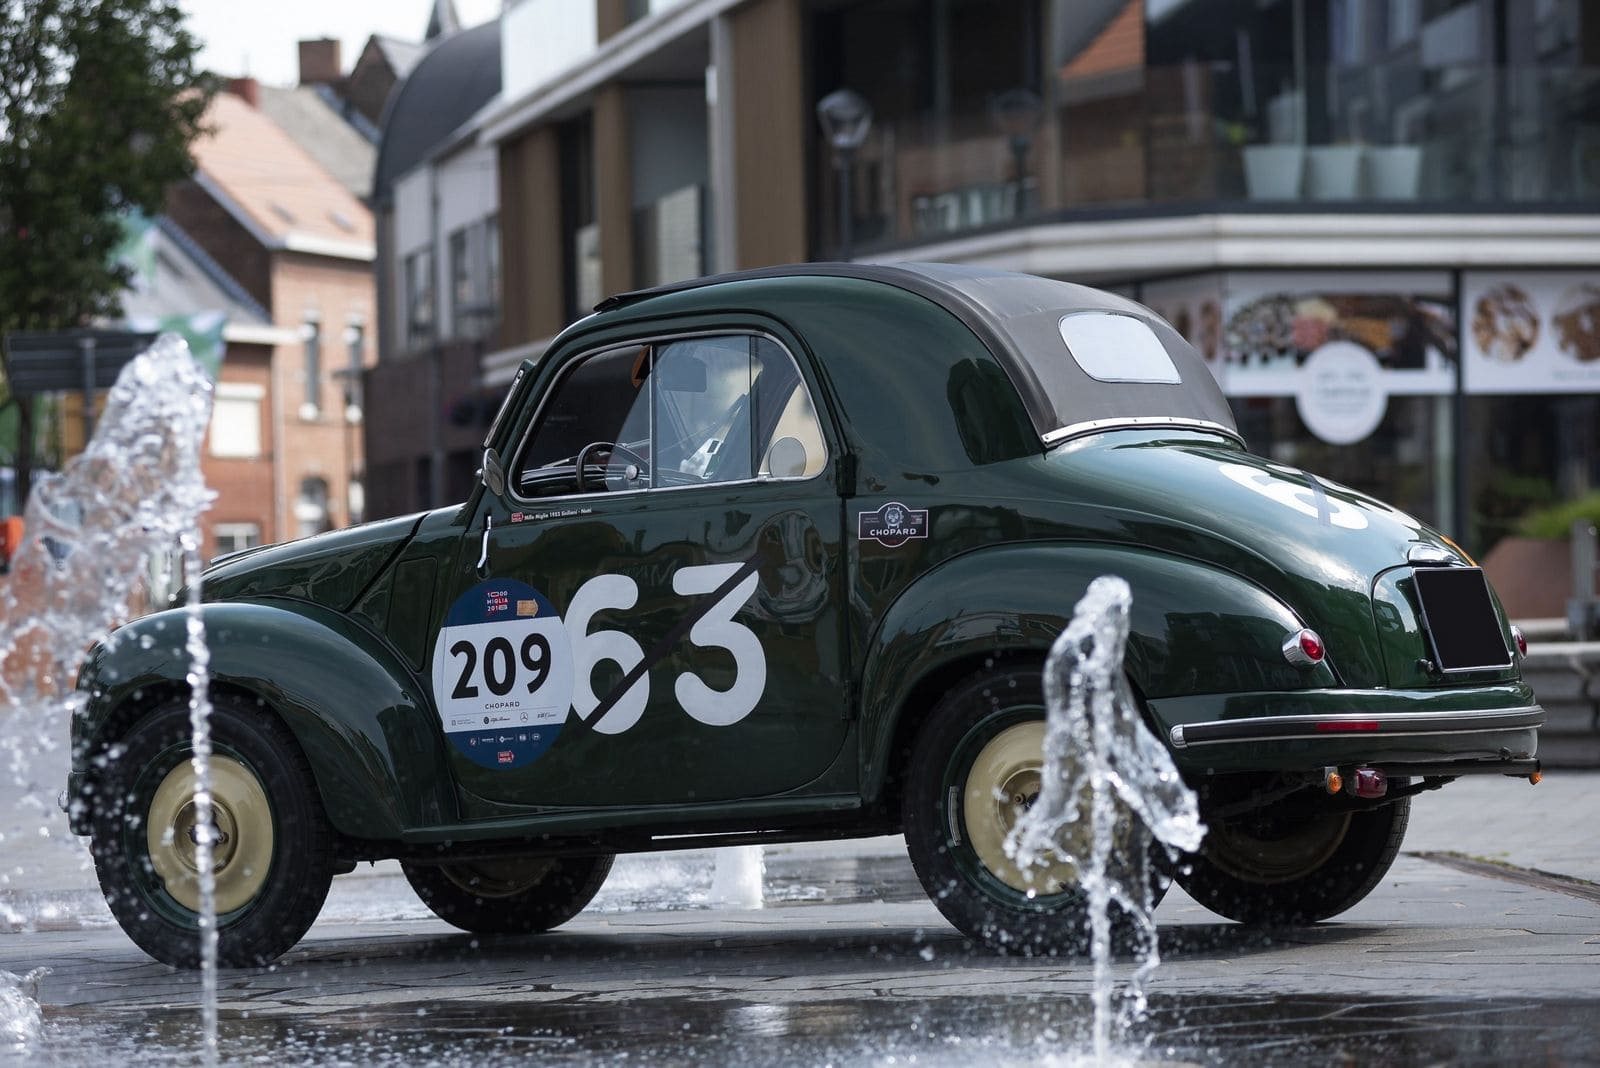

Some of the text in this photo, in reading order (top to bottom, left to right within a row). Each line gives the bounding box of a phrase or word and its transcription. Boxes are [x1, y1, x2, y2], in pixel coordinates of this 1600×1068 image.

[870, 528, 917, 536] CHOPARD
[450, 633, 552, 699] 209
[564, 562, 767, 735] 63
[484, 701, 520, 710] CHOPARD
